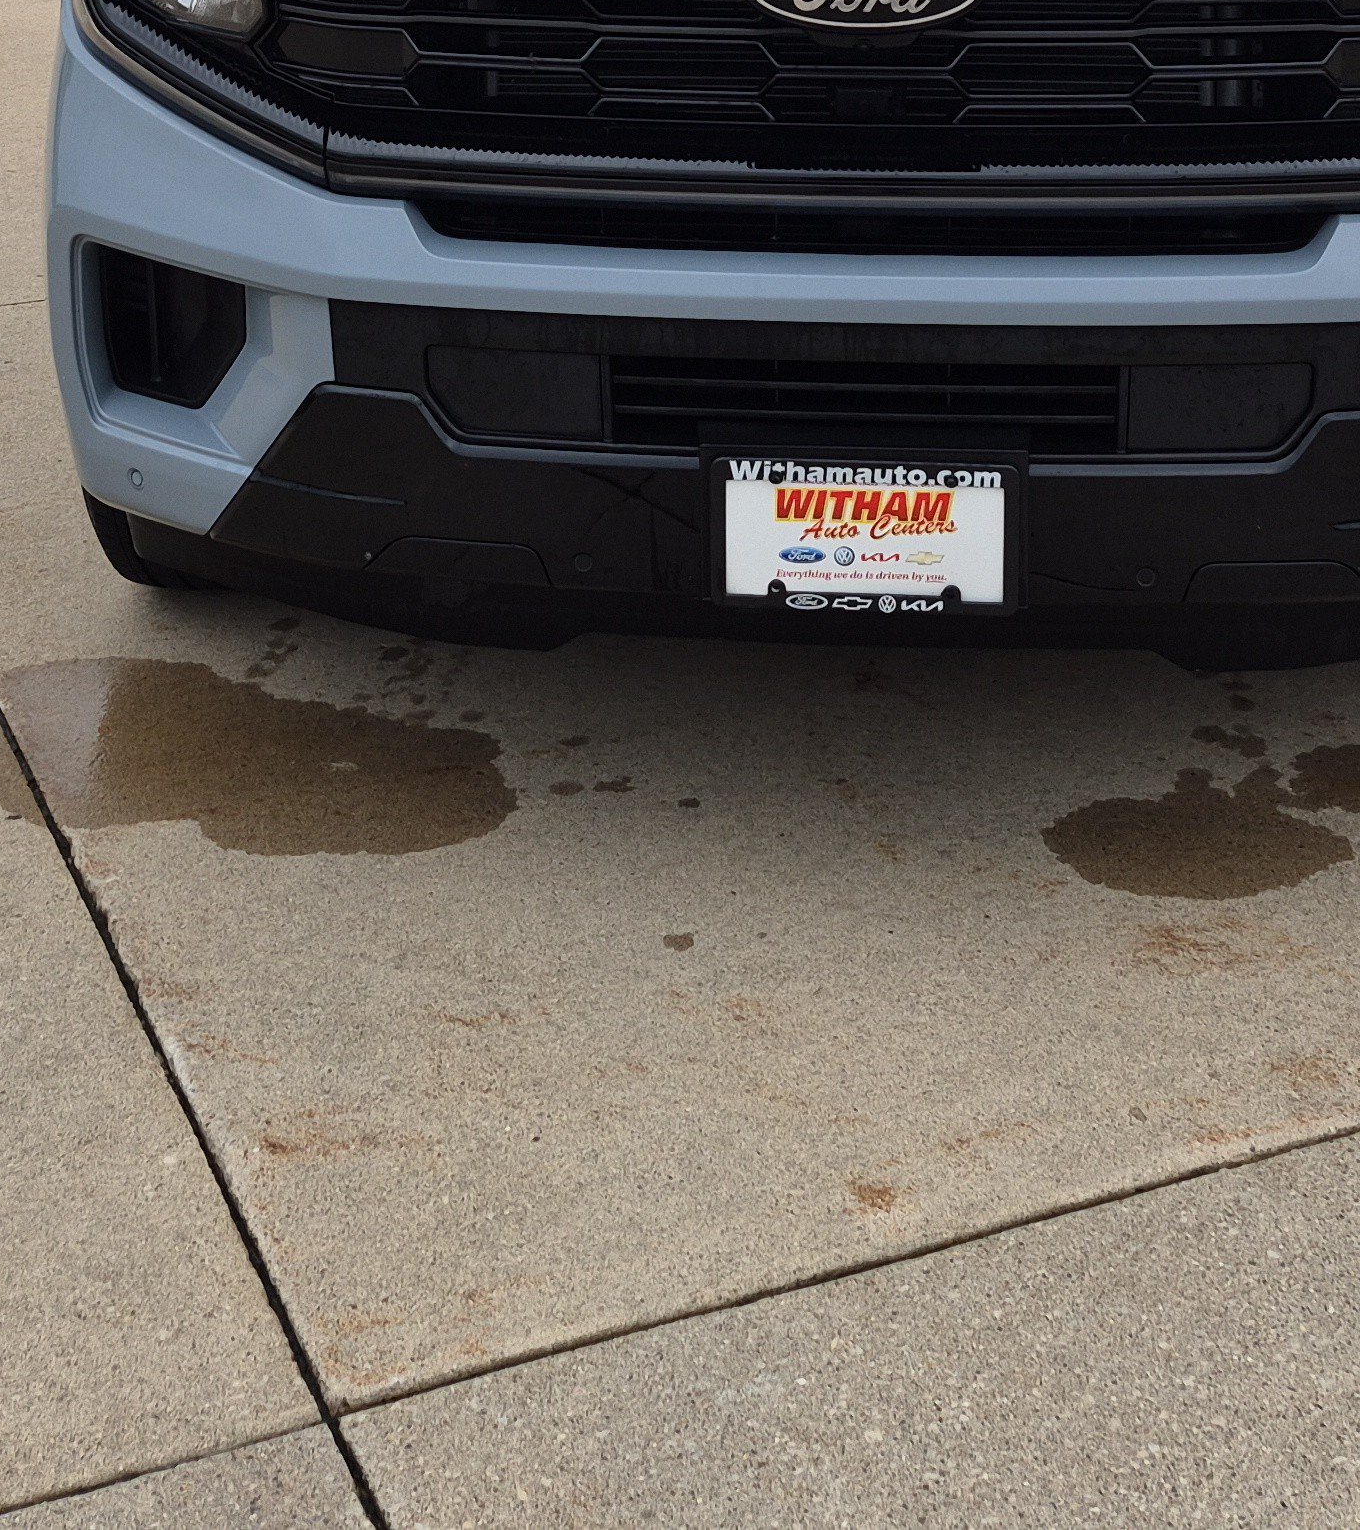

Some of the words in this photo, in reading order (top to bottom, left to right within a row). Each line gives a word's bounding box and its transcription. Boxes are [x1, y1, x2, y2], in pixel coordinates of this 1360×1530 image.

[729, 459, 1002, 488] Withamauto.com
[775, 488, 954, 523] WITHAM
[799, 518, 860, 542] Auto
[869, 514, 958, 541] Centers
[776, 569, 832, 581] Everything
[849, 570, 863, 580] do
[865, 571, 874, 580] is
[875, 571, 910, 580] driven
[911, 572, 925, 583] by
